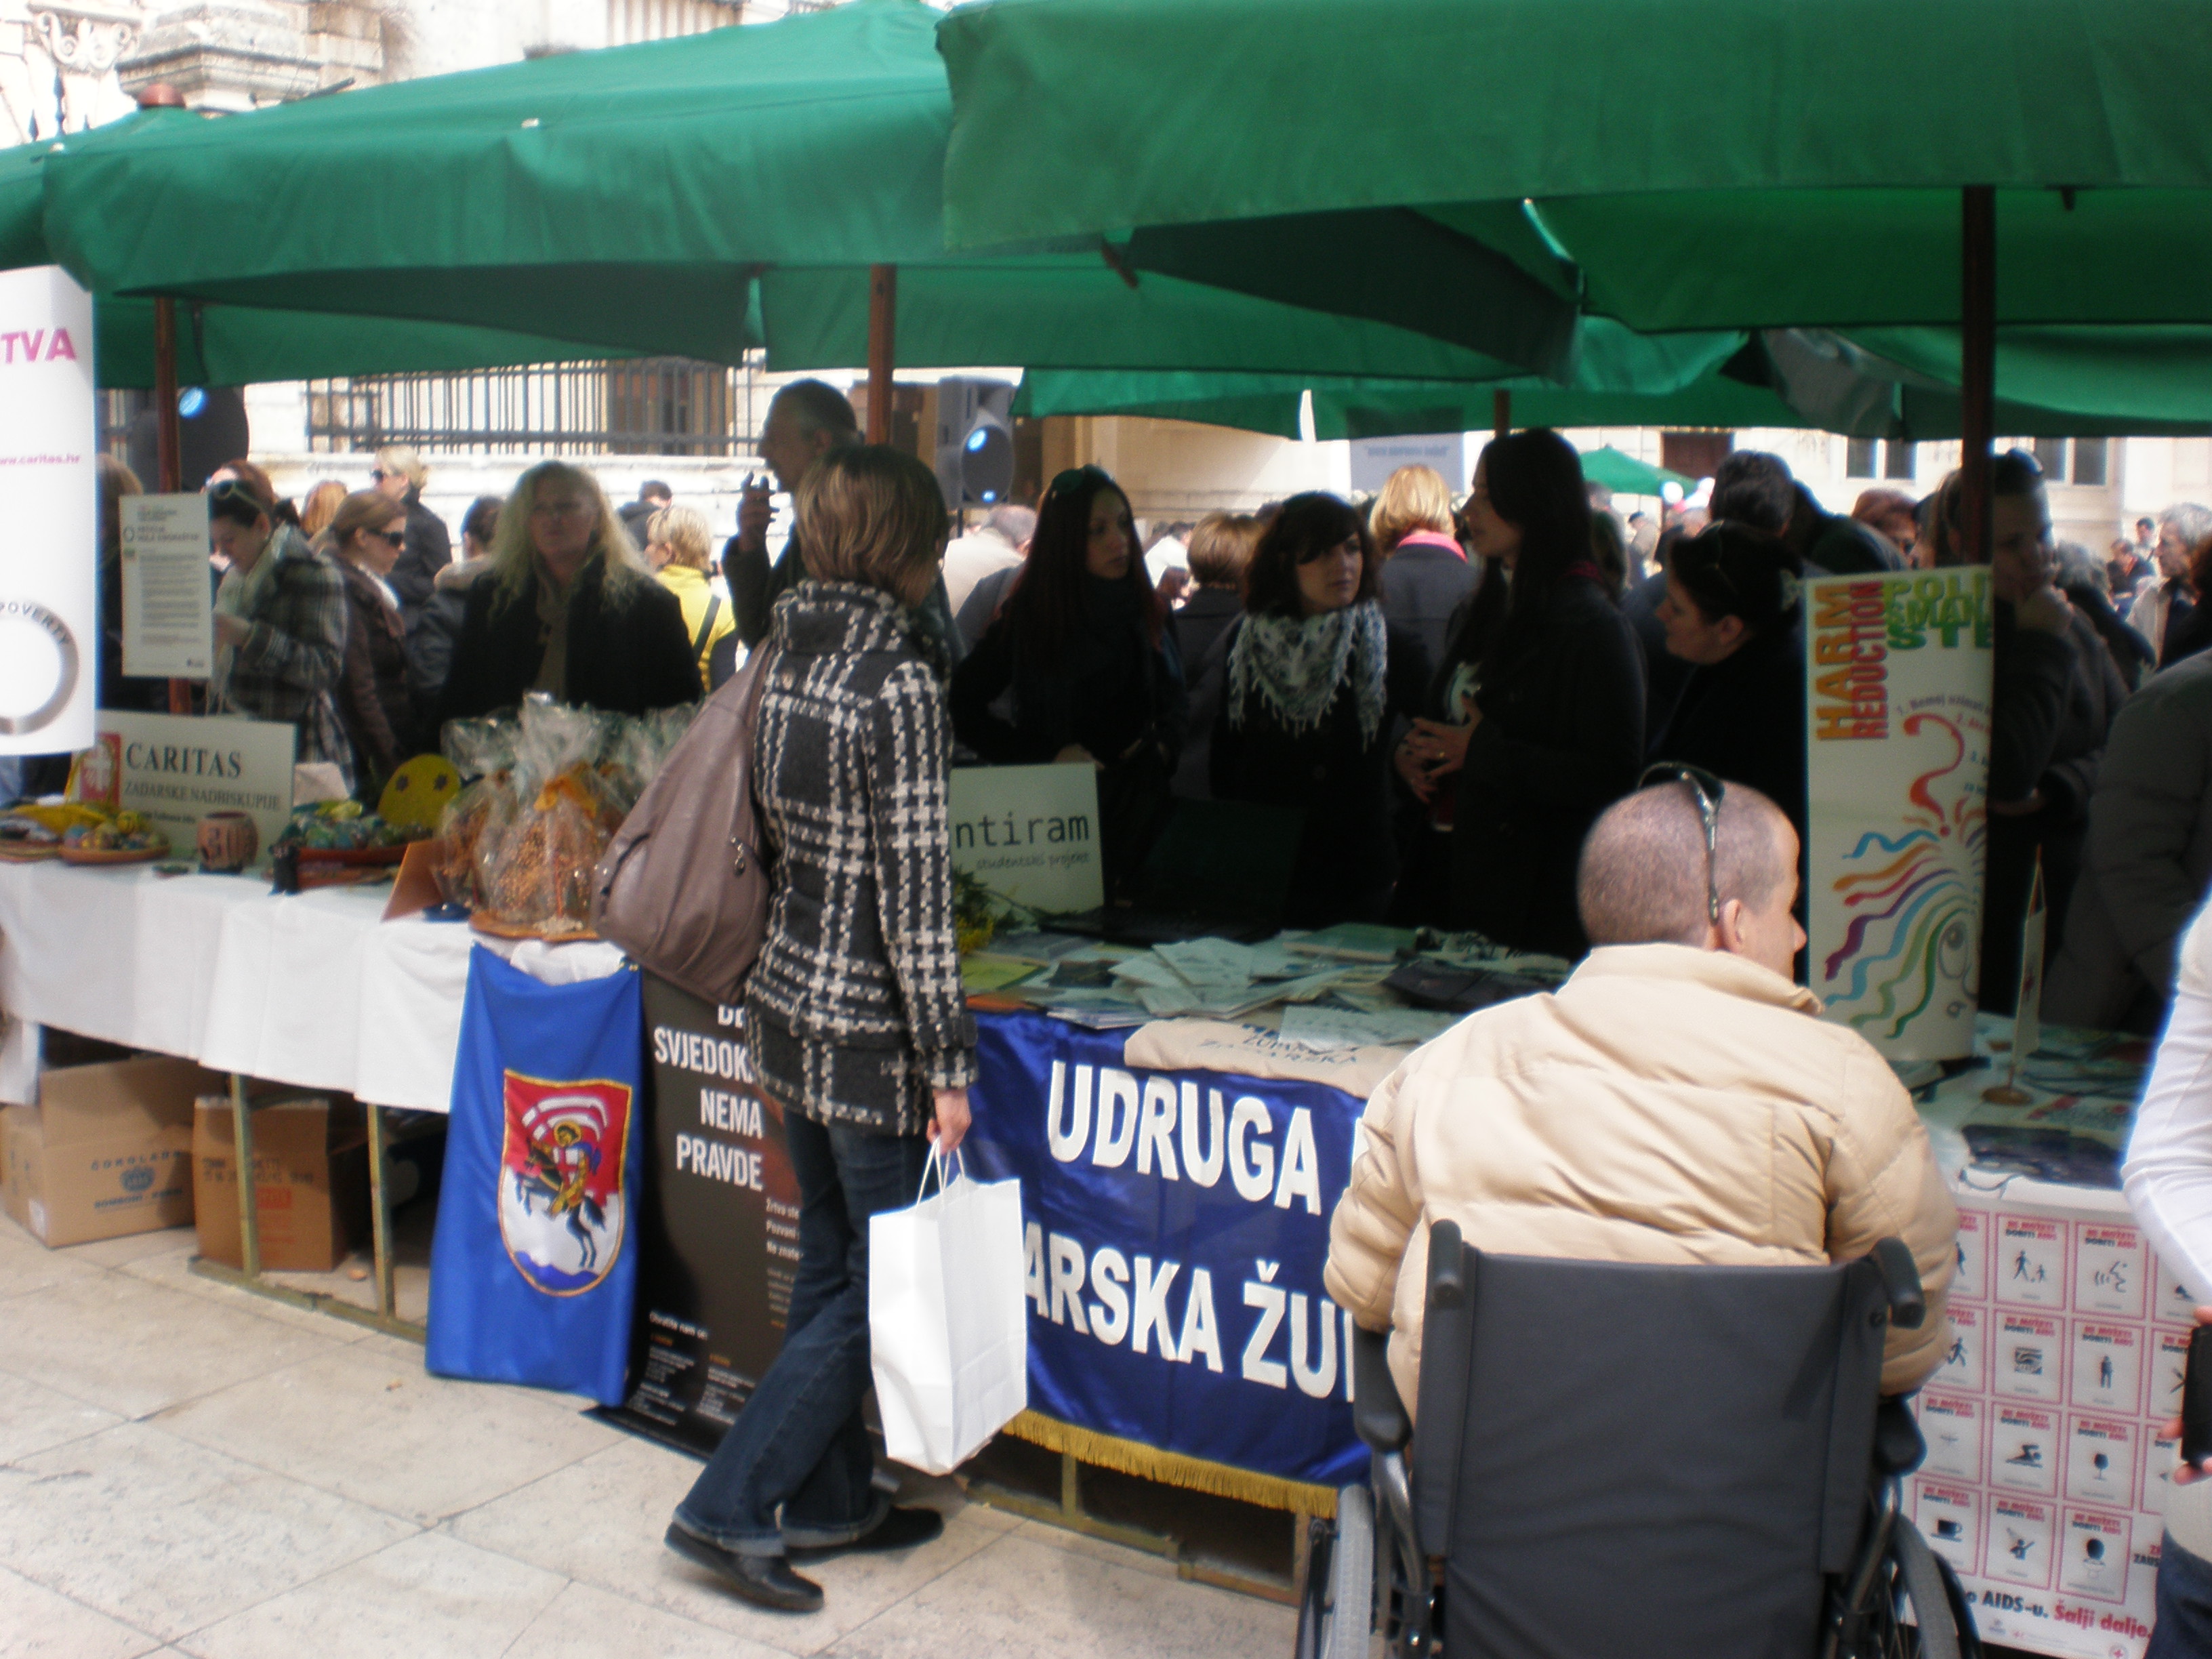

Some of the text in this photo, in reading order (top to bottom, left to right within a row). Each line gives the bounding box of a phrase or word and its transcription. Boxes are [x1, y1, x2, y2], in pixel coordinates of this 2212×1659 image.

[0, 328, 77, 364] TVA
[1816, 583, 1852, 741] HARM
[1849, 580, 1888, 739] REDUCTION
[125, 742, 242, 779] CARITAS
[955, 811, 1089, 849] ntiram
[654, 1025, 754, 1084] SVJEDOK
[700, 1087, 764, 1140] NEMA
[1048, 1059, 1322, 1216] UDRUGA
[676, 1132, 764, 1193] PRAVDE
[1024, 1221, 1223, 1373] ARSKA
[1982, 1590, 2049, 1619] AIDS-u.
[2054, 1599, 2095, 1631] Šalji
